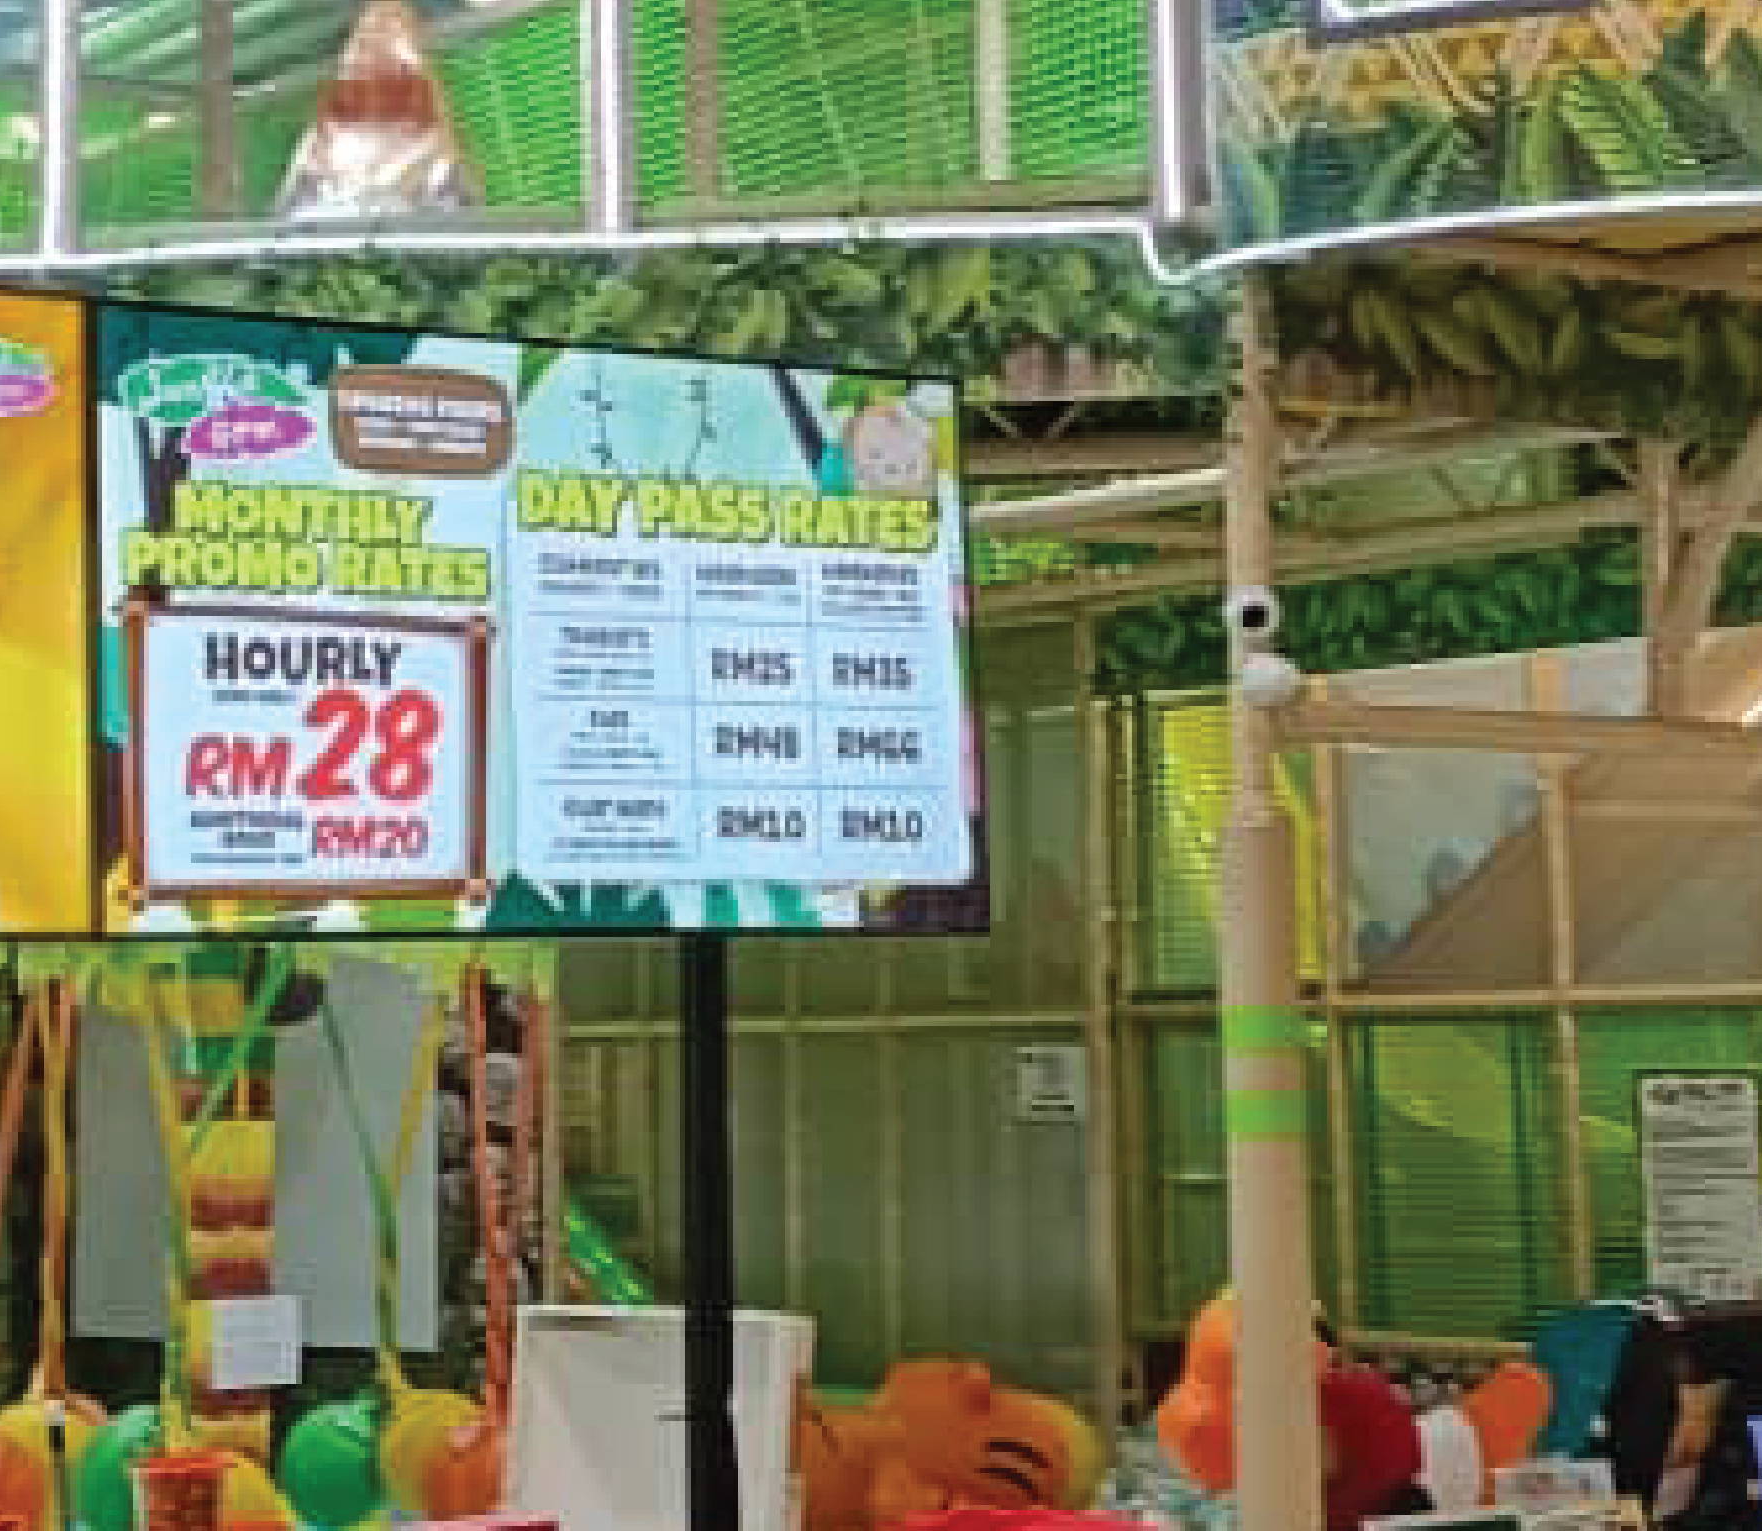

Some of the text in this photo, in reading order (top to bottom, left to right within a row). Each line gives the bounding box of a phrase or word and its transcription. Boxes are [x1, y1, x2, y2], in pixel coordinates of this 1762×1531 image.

[175, 480, 433, 548] MONTHLY
[516, 468, 941, 554] DAY PASS RATES
[123, 529, 323, 595] PROMO
[334, 542, 492, 601] RATES
[203, 630, 403, 687] HOURLY
[310, 815, 431, 859] RM20
[715, 805, 808, 843] RM10
[841, 805, 925, 844] RM10
